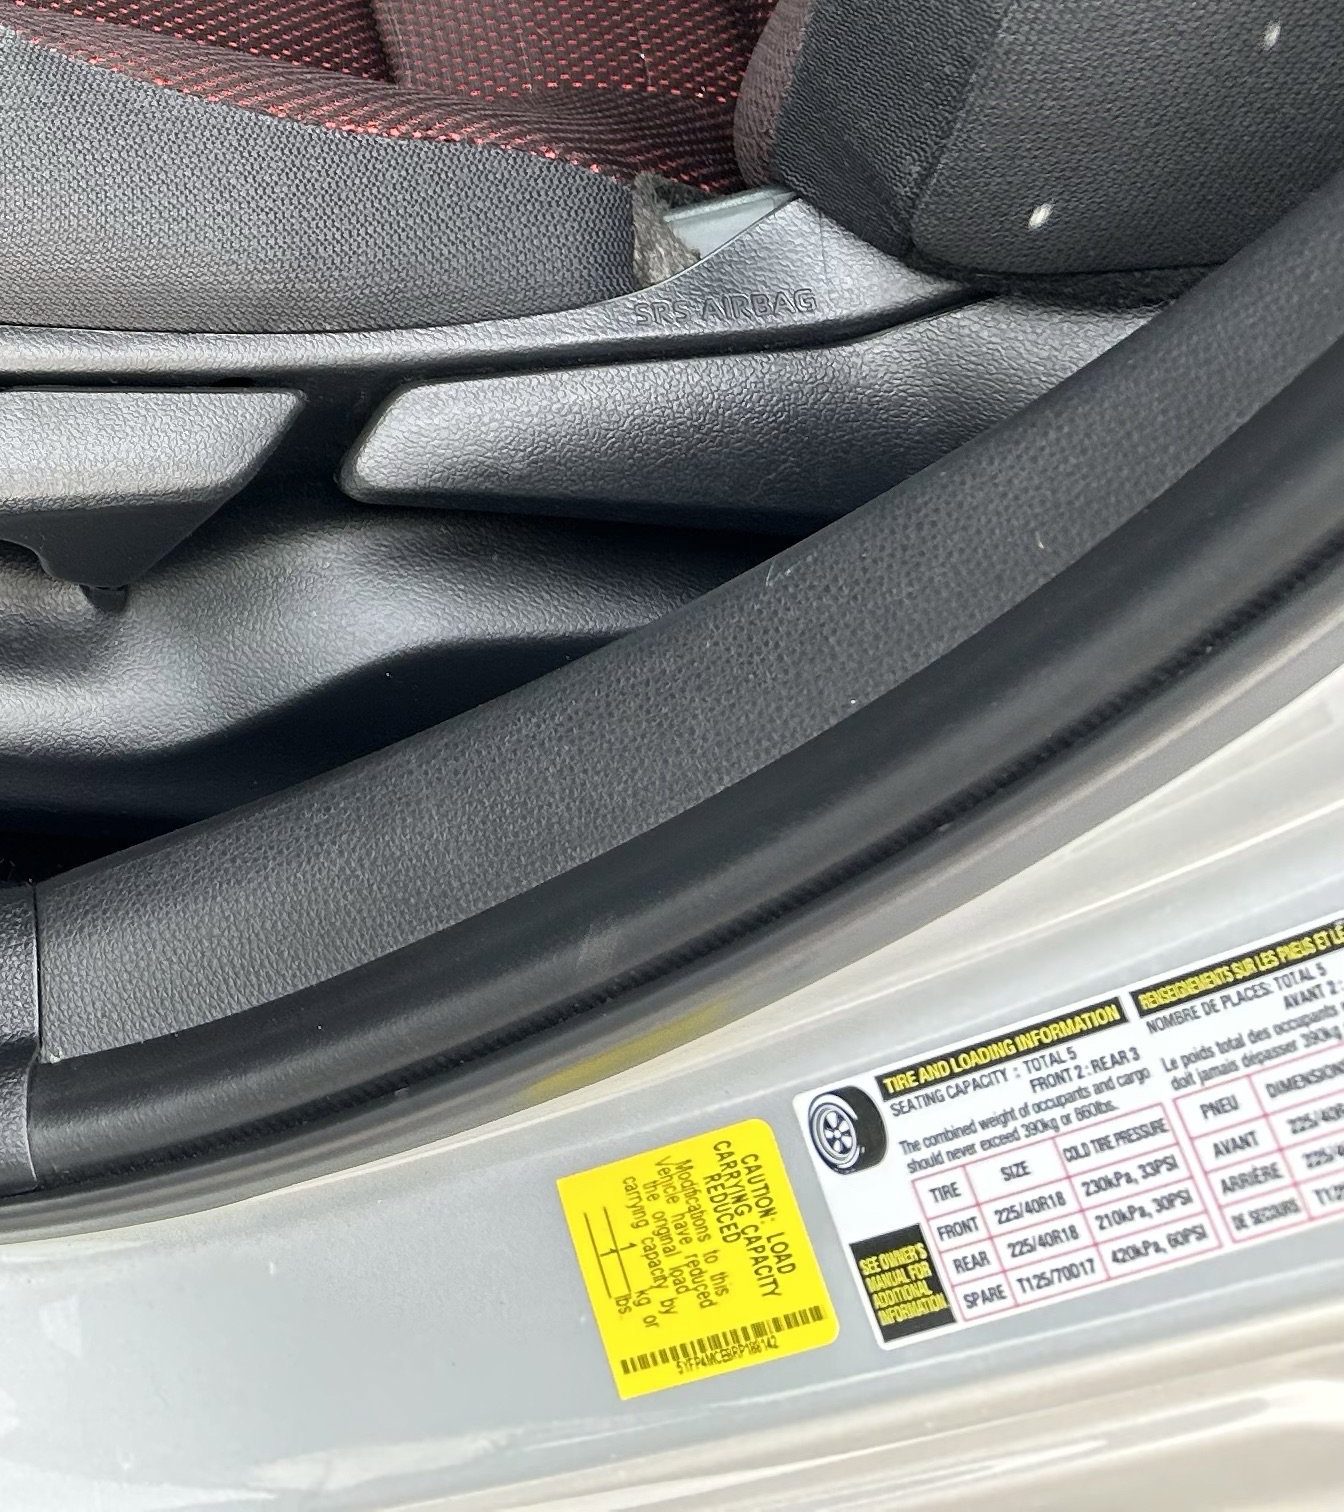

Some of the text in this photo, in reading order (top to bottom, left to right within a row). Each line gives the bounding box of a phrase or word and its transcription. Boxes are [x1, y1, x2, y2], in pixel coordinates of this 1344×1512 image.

[633, 287, 817, 328] SRS AIRBAG
[1146, 967, 1317, 1034] NOMBRE DE TOTAL
[882, 1004, 1122, 1095] TIRE AND LOADING INFORMATION
[889, 1047, 1077, 1117] SEATING CAPACITY TOTAL 5
[1029, 1069, 1075, 1094] FRONT
[1091, 1050, 1128, 1074] REAR
[1128, 1046, 1141, 1062] 3
[899, 1067, 1152, 1157] The combined weight of occupants and cargo
[907, 1150, 945, 1174] should
[946, 1143, 979, 1163] never
[980, 1129, 1021, 1154] exceed
[1060, 1110, 1073, 1126] or
[1213, 1130, 1260, 1159] AVANT
[929, 1182, 962, 1204] TIRE
[1000, 1161, 1032, 1182] SIZE
[1063, 1142, 1091, 1163] COLD
[1112, 1118, 1170, 1146] PRESSURE
[643, 1180, 691, 1295] the original load
[654, 1155, 718, 1310] Vehicle have reduced
[674, 1159, 730, 1297] Modifications to this
[703, 1174, 742, 1244] REDUCED
[713, 1140, 782, 1297] CARRYING CAPACITY
[740, 1153, 797, 1275] CAUTION: LOAD
[937, 1216, 980, 1242] FRONT
[994, 1191, 1067, 1226] 225/40R18
[622, 1175, 680, 1316] carrying capacity by
[859, 1256, 881, 1276] SEE
[865, 1261, 933, 1294] MANUAL FOR
[952, 1250, 991, 1275] REAR
[1007, 1225, 1080, 1259] 225/40R18
[632, 1288, 652, 1308] kg
[643, 1315, 660, 1329] or
[872, 1280, 934, 1310] ADDITIONAL
[877, 1292, 948, 1327] INFORMATION
[963, 1284, 1008, 1310] SPARE
